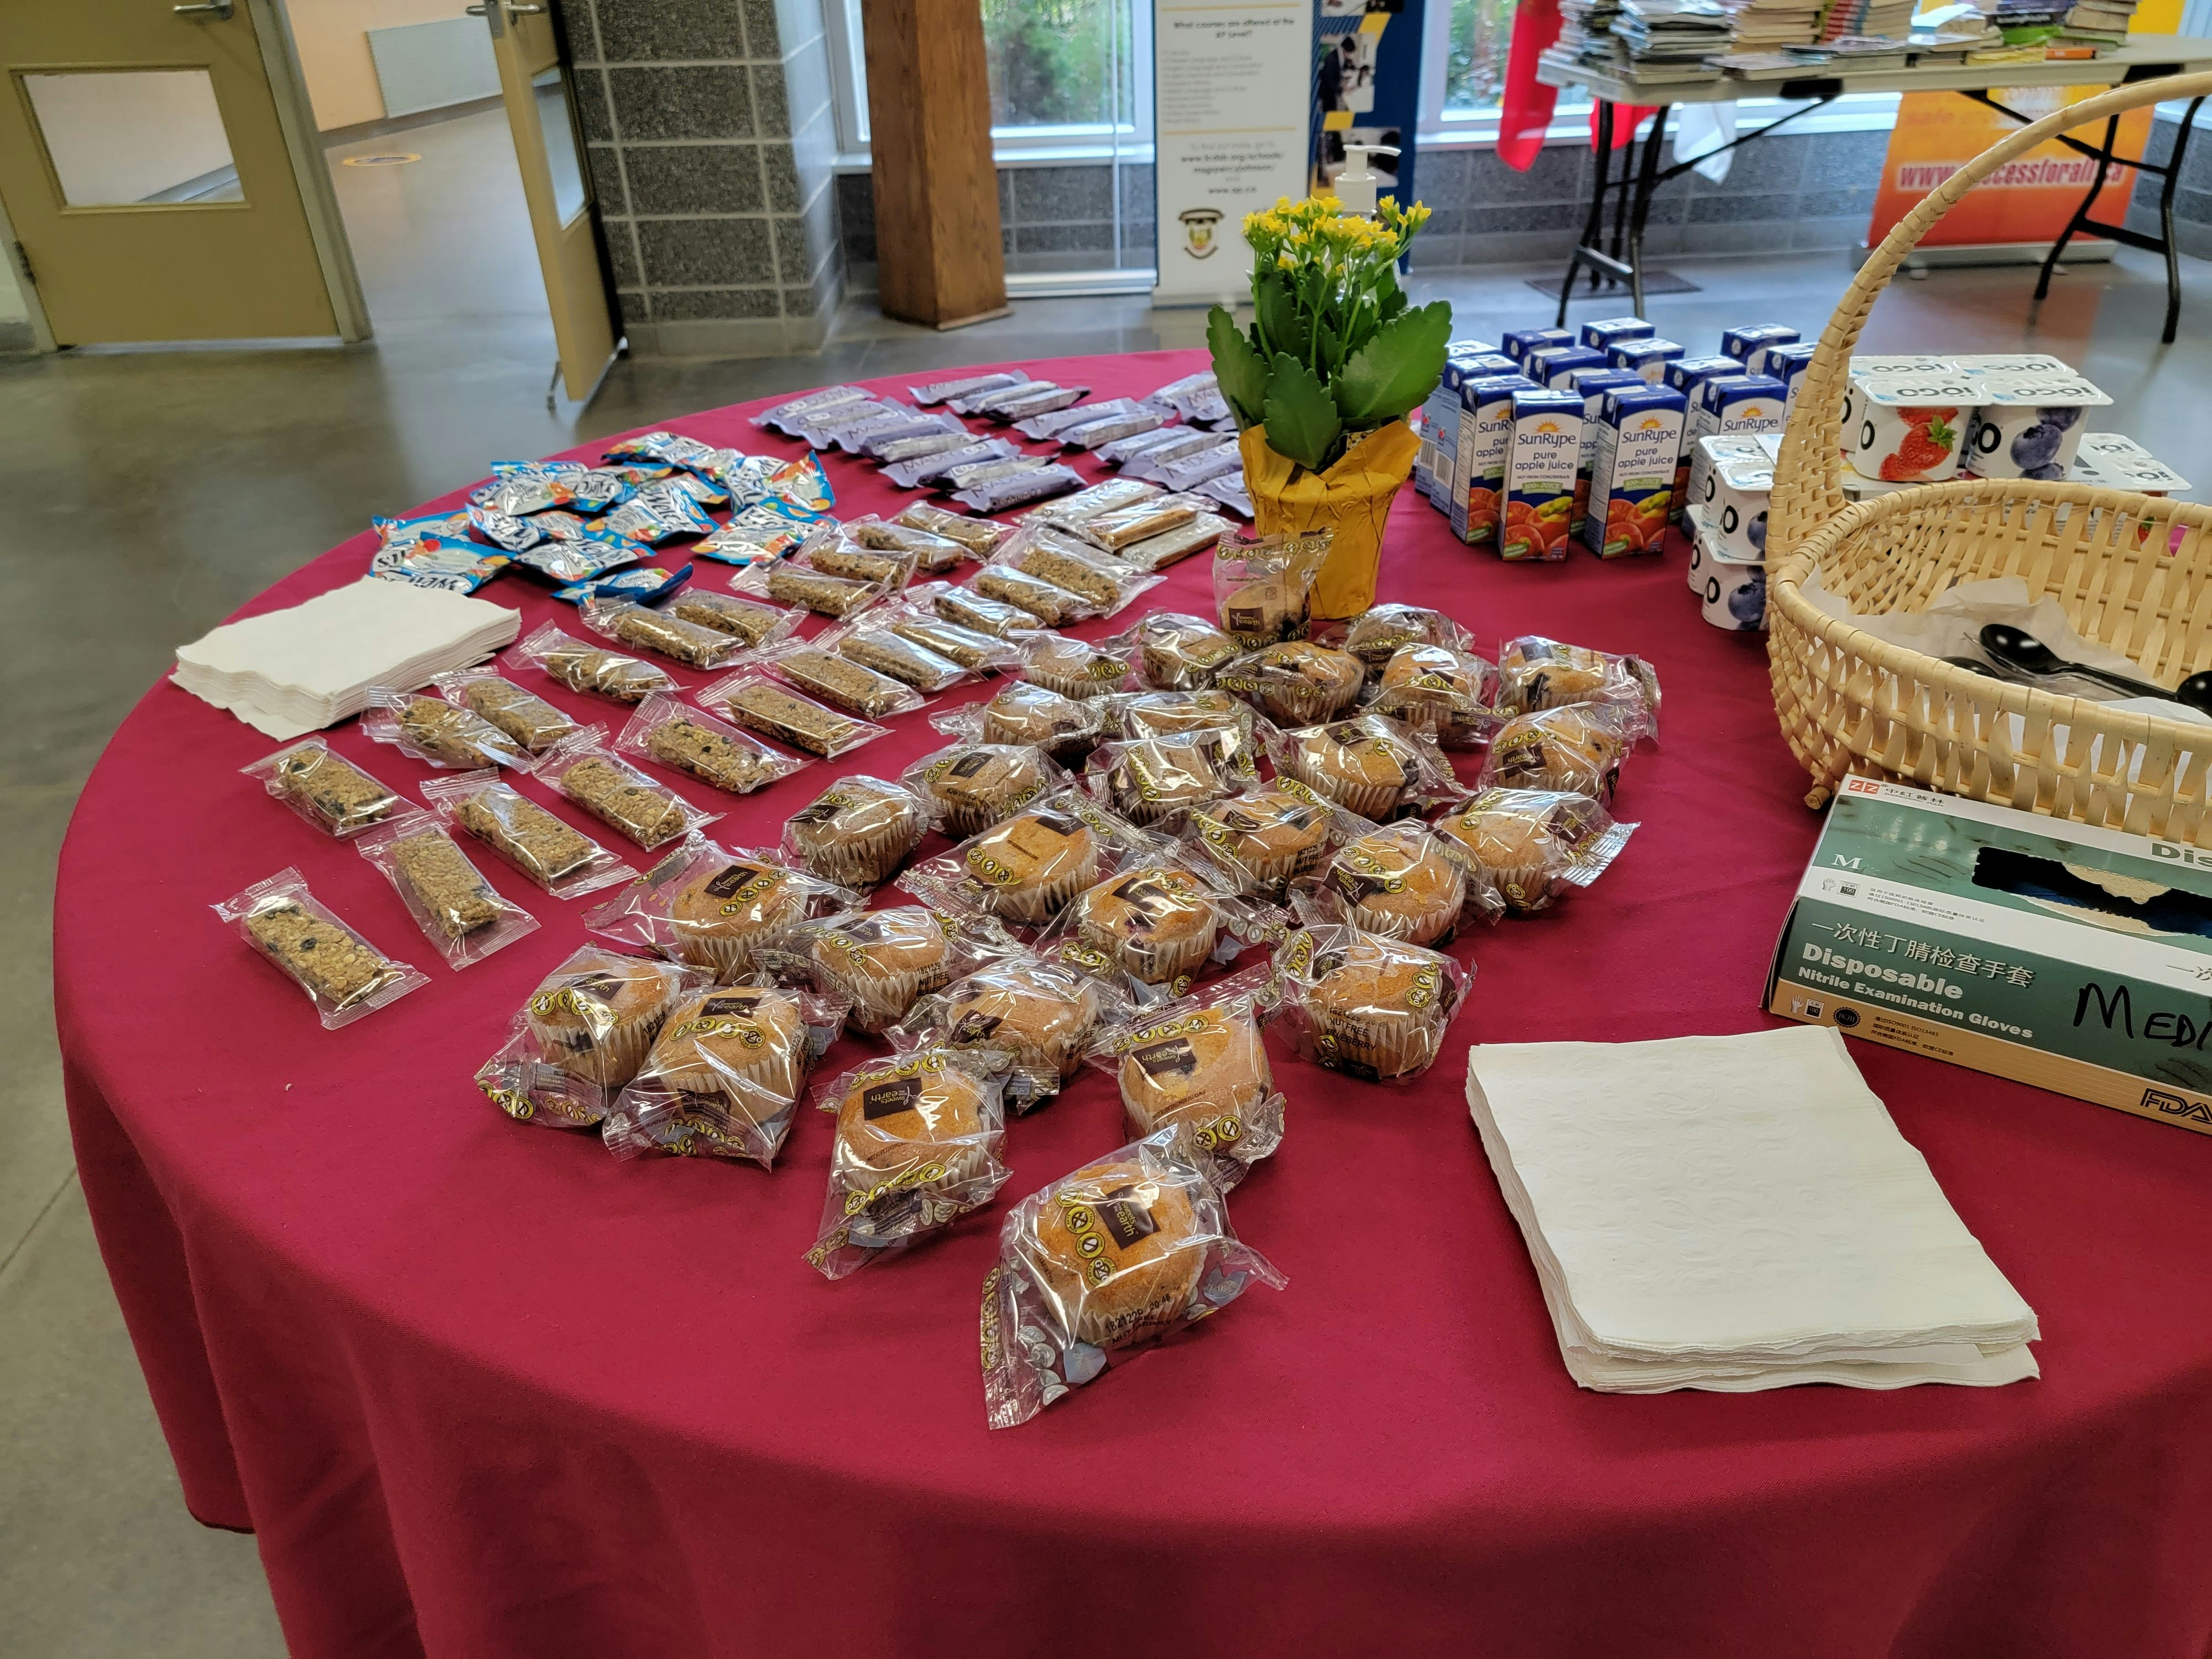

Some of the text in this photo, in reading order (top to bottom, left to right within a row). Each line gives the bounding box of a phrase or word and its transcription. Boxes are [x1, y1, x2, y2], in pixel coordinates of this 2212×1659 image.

[1478, 419, 1509, 434] SunR
[1723, 418, 1778, 432] SunRype
[1493, 437, 1509, 448] pur
[1517, 433, 1577, 448] SunRype
[1622, 429, 1677, 444] SunRype
[1476, 447, 1504, 458] apple
[1533, 451, 1557, 461] pure
[1635, 447, 1658, 458] pure
[1515, 460, 1574, 471] apple juice
[1618, 456, 1674, 469] apple juice
[1296, 856, 1308, 865] NUT
[1832, 853, 1864, 871] M
[1293, 864, 1315, 875] BLUEB
[1337, 868, 1354, 884] earth
[729, 870, 749, 885] earth
[917, 962, 941, 975] 1821229
[1802, 942, 1964, 1000] Disposable
[918, 971, 950, 987] NUT FREE
[1798, 966, 2034, 1039] Nitrile Examination Gloves
[1329, 1017, 1369, 1038] NUT FREE
[1326, 1028, 1376, 1051] BLUEBERRY
[1141, 1051, 1168, 1062] earth
[1152, 1054, 1177, 1064] sweets
[870, 1091, 898, 1102] earth
[880, 1094, 906, 1104] sweets
[2140, 1088, 2212, 1124] FDA
[1121, 1201, 1137, 1225] sweets
[1116, 1210, 1136, 1237] earth
